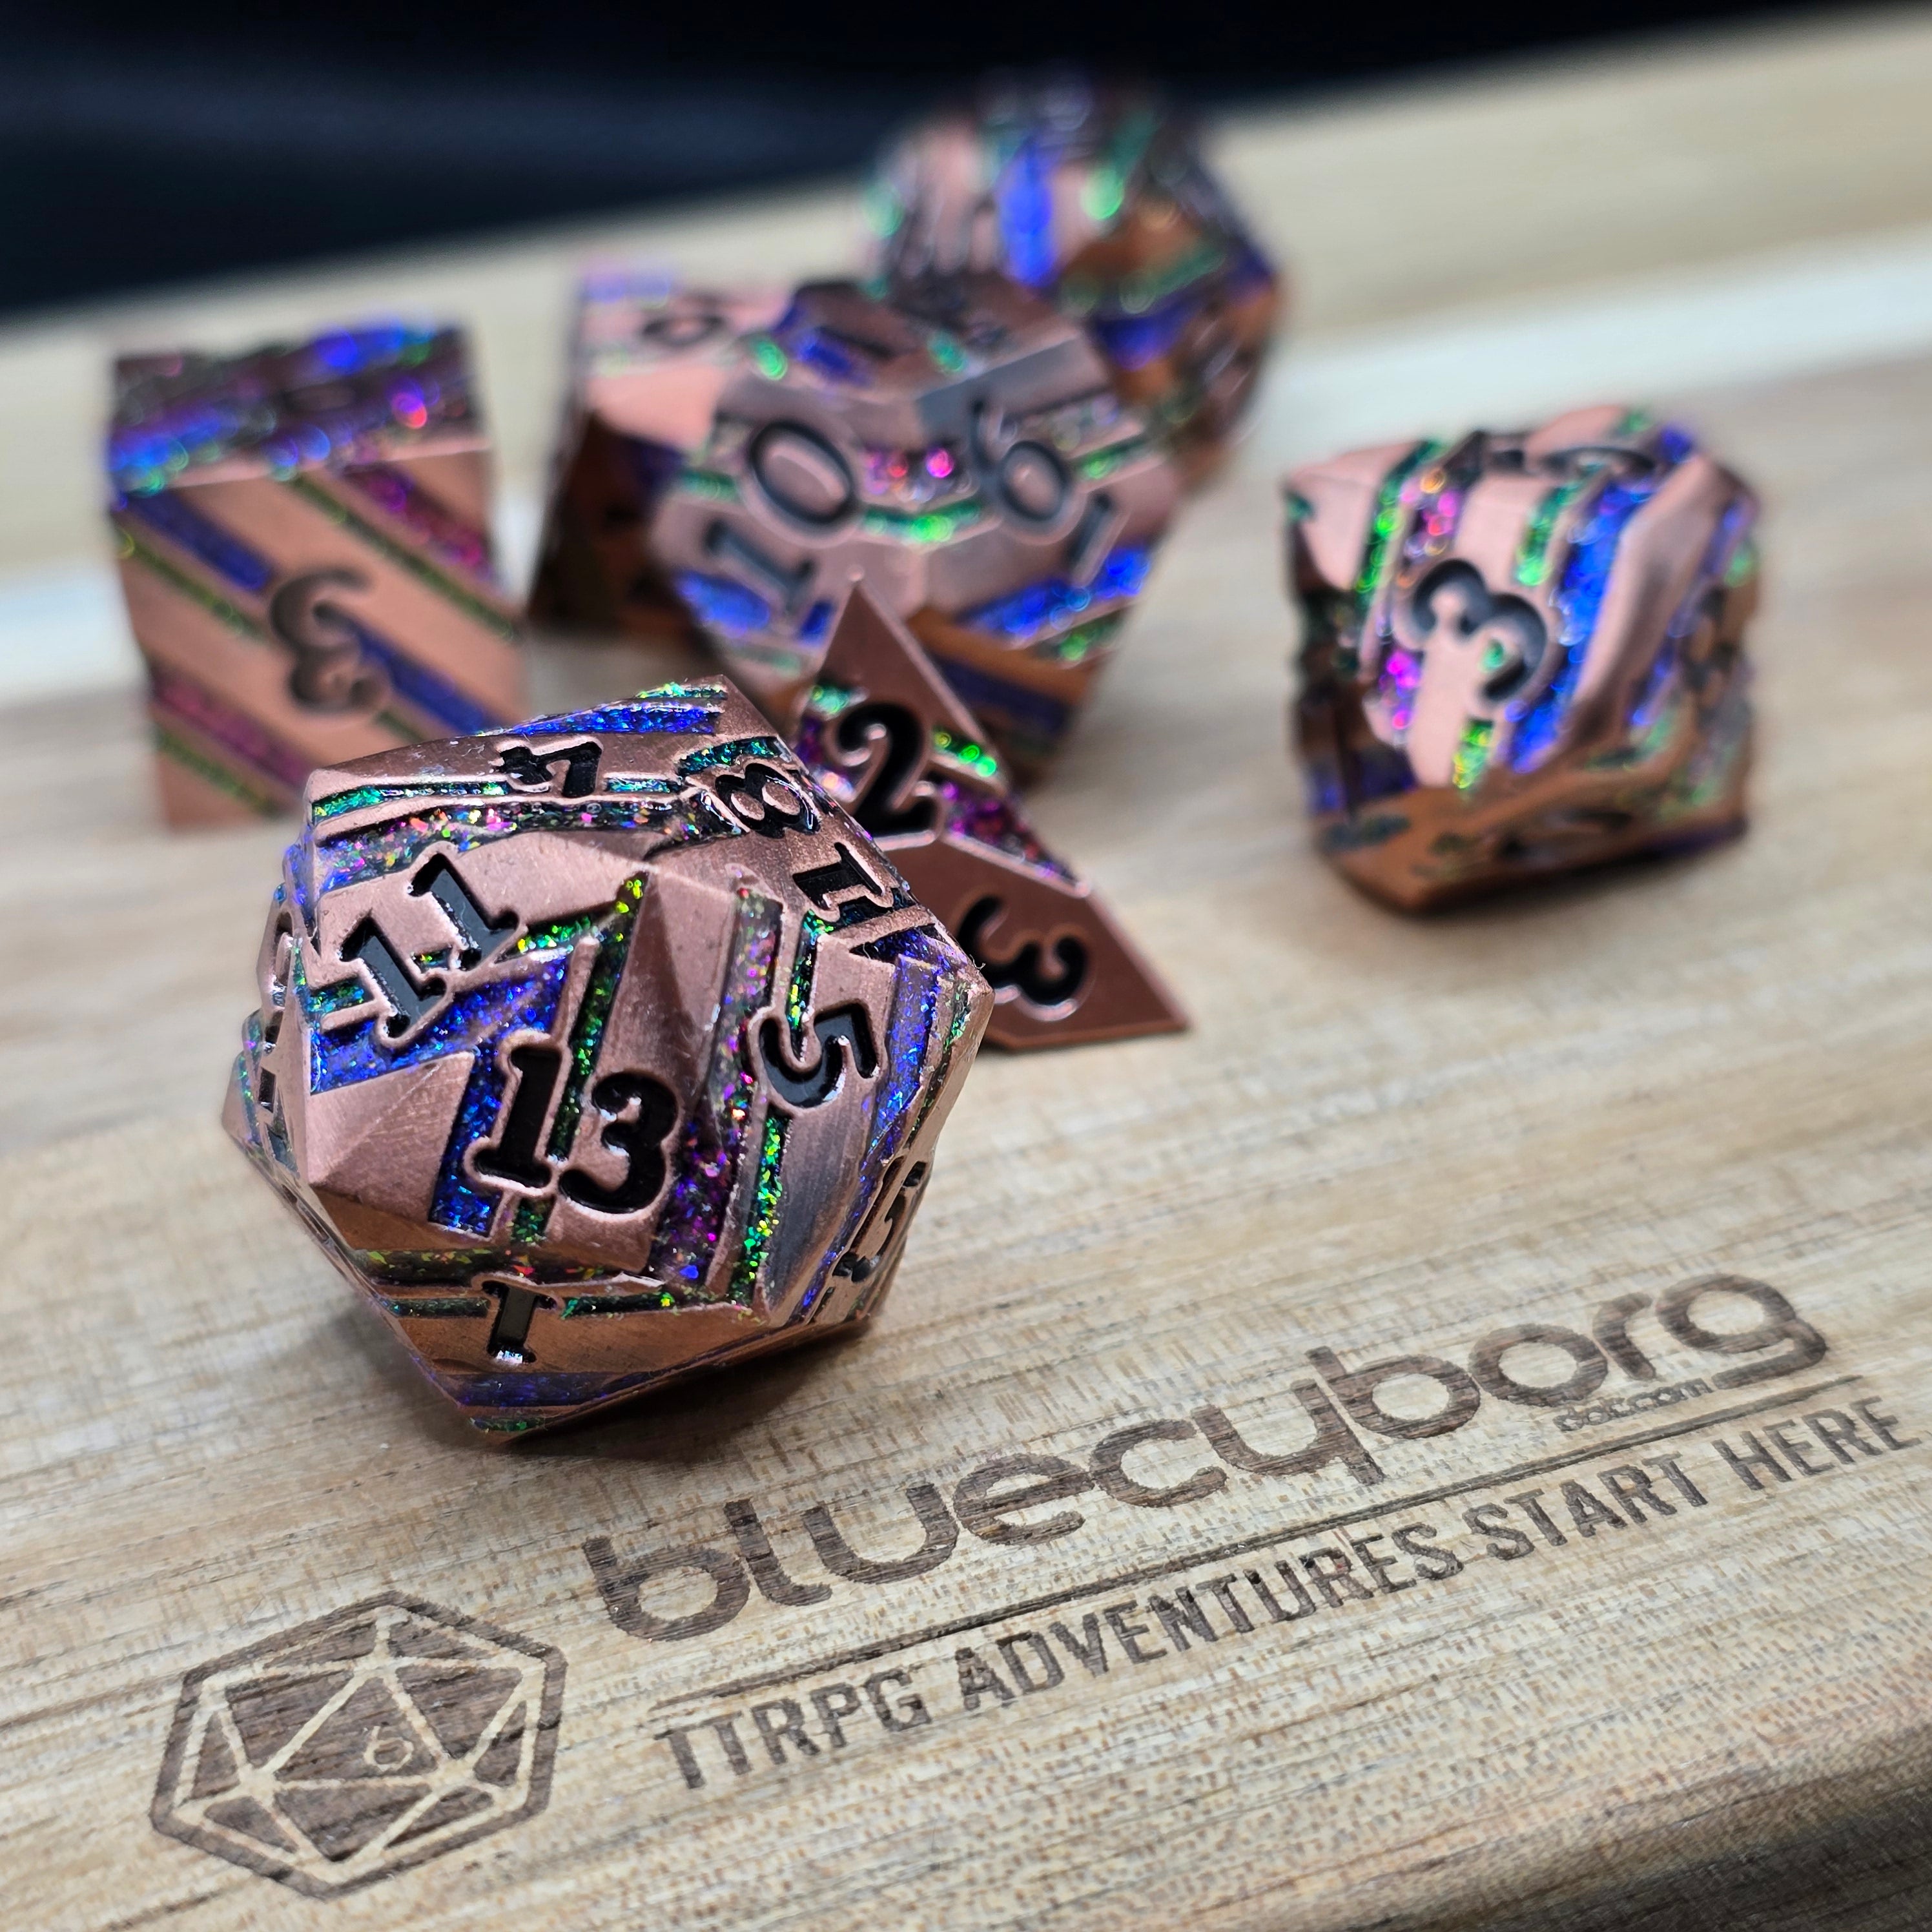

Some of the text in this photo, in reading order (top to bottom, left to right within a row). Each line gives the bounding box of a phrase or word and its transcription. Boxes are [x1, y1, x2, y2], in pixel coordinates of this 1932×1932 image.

[836, 703, 936, 837] 2
[340, 853, 517, 1038] 11
[471, 1047, 679, 1213] 13
[759, 1002, 879, 1108] 5
[582, 1273, 1829, 1643] bluecyborg
[653, 1395, 1921, 1789] TTRPG ADVENTURES START HERE
